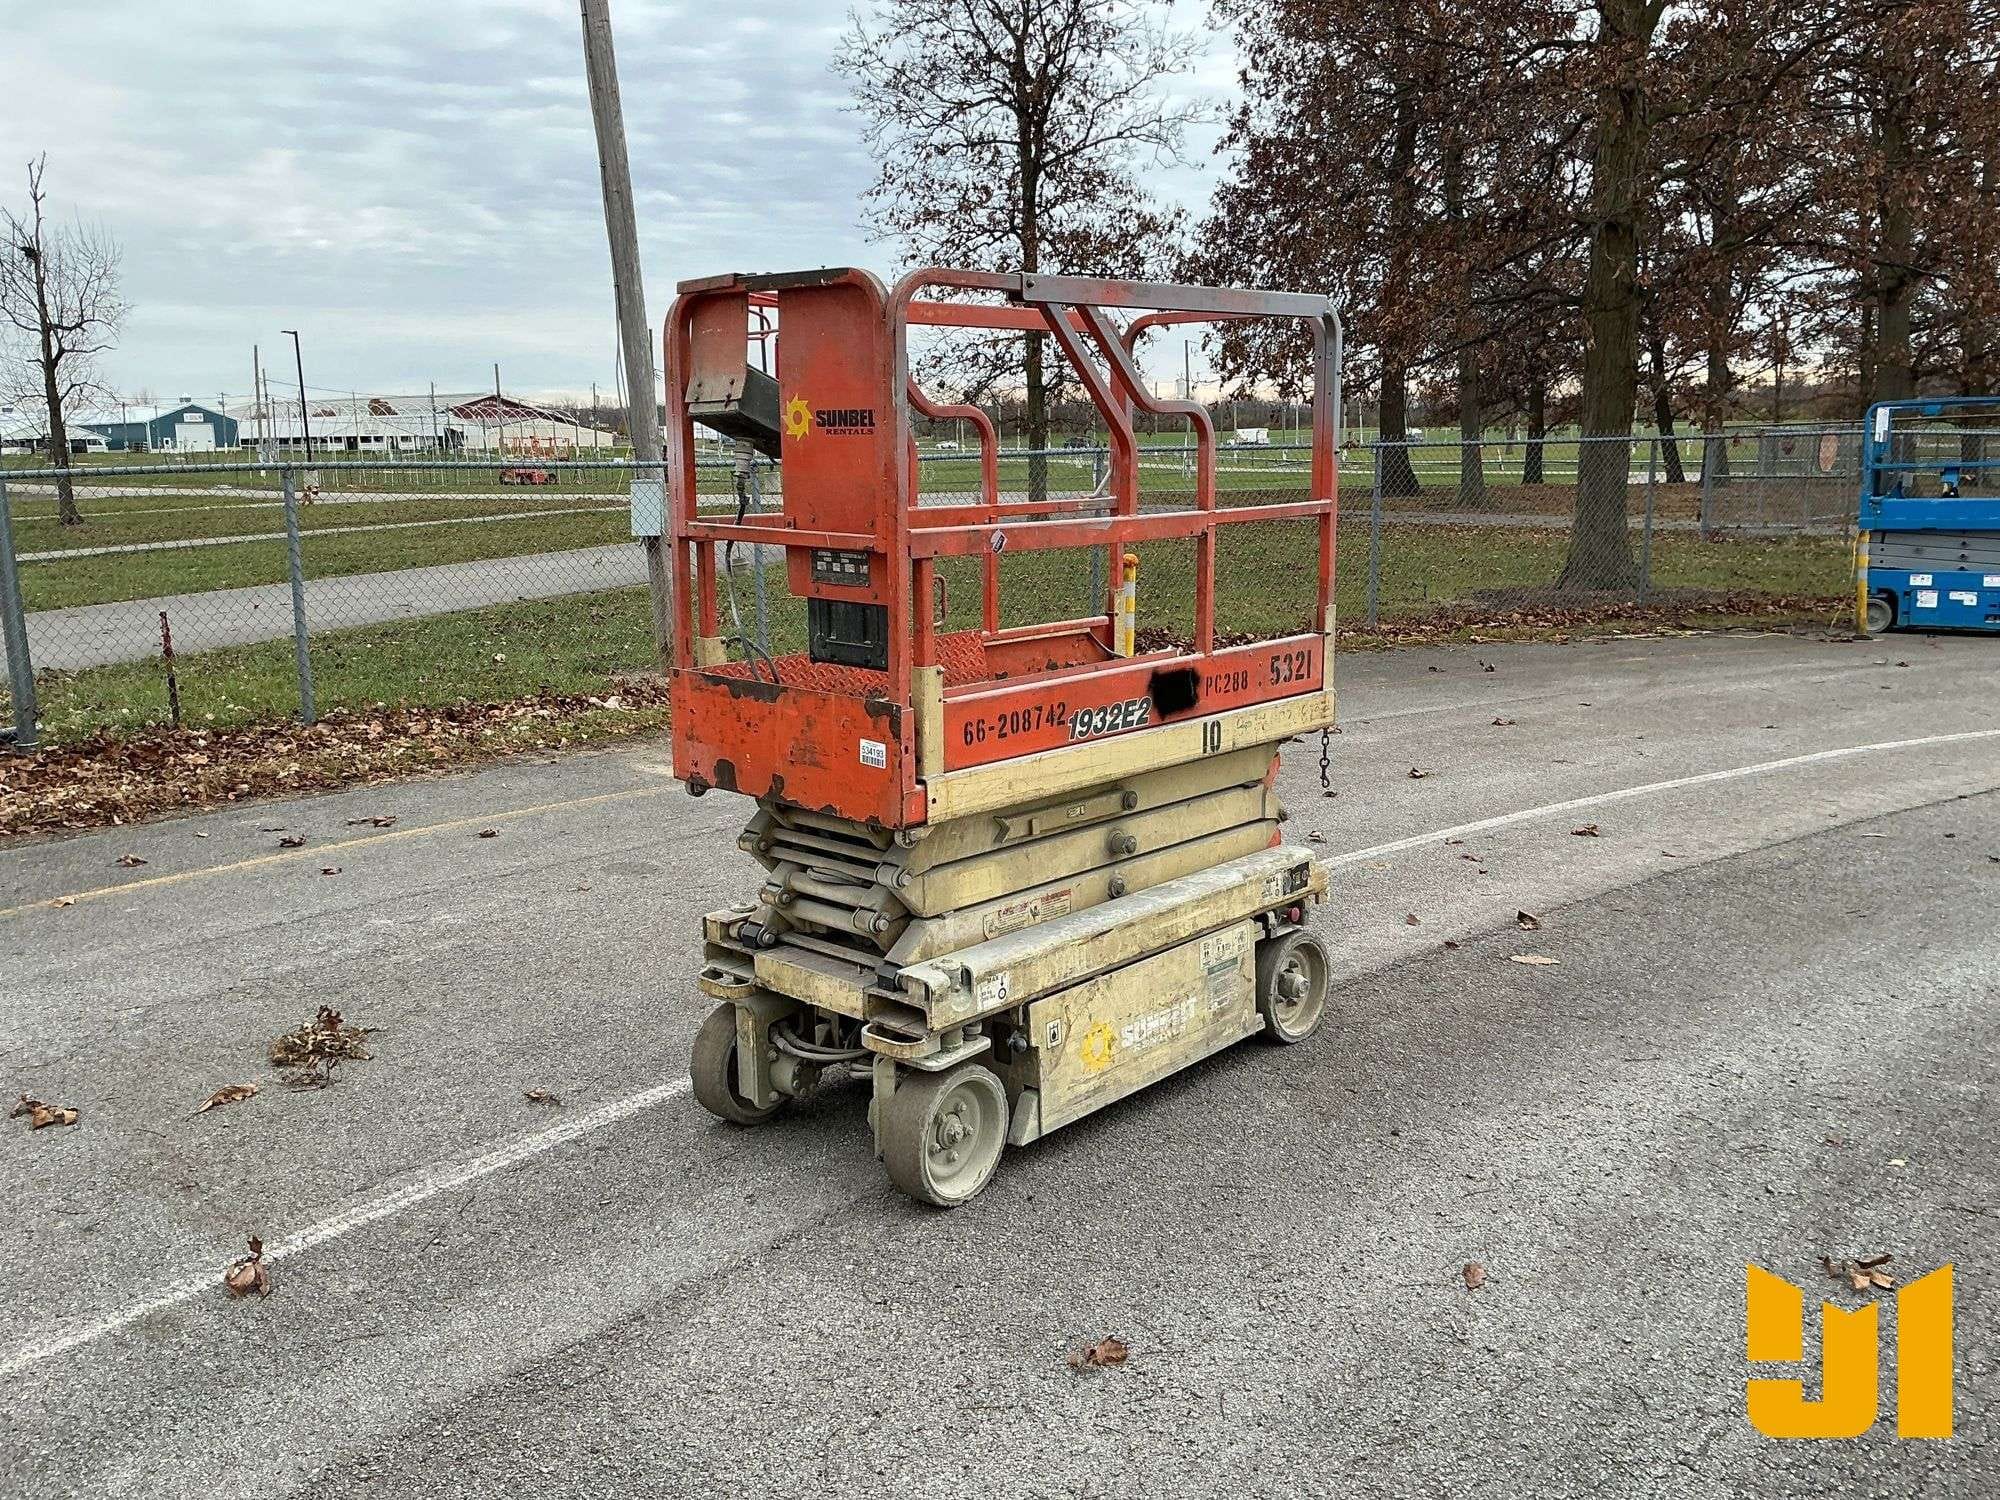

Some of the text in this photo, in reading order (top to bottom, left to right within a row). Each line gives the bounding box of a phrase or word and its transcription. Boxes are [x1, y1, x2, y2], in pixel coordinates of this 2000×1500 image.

[825, 428, 874, 436] RENTALS
[1205, 670, 1248, 696] PC288
[1270, 649, 1312, 686] 5321
[963, 702, 1066, 746] 66-208742
[1068, 696, 1152, 741] 1932E2
